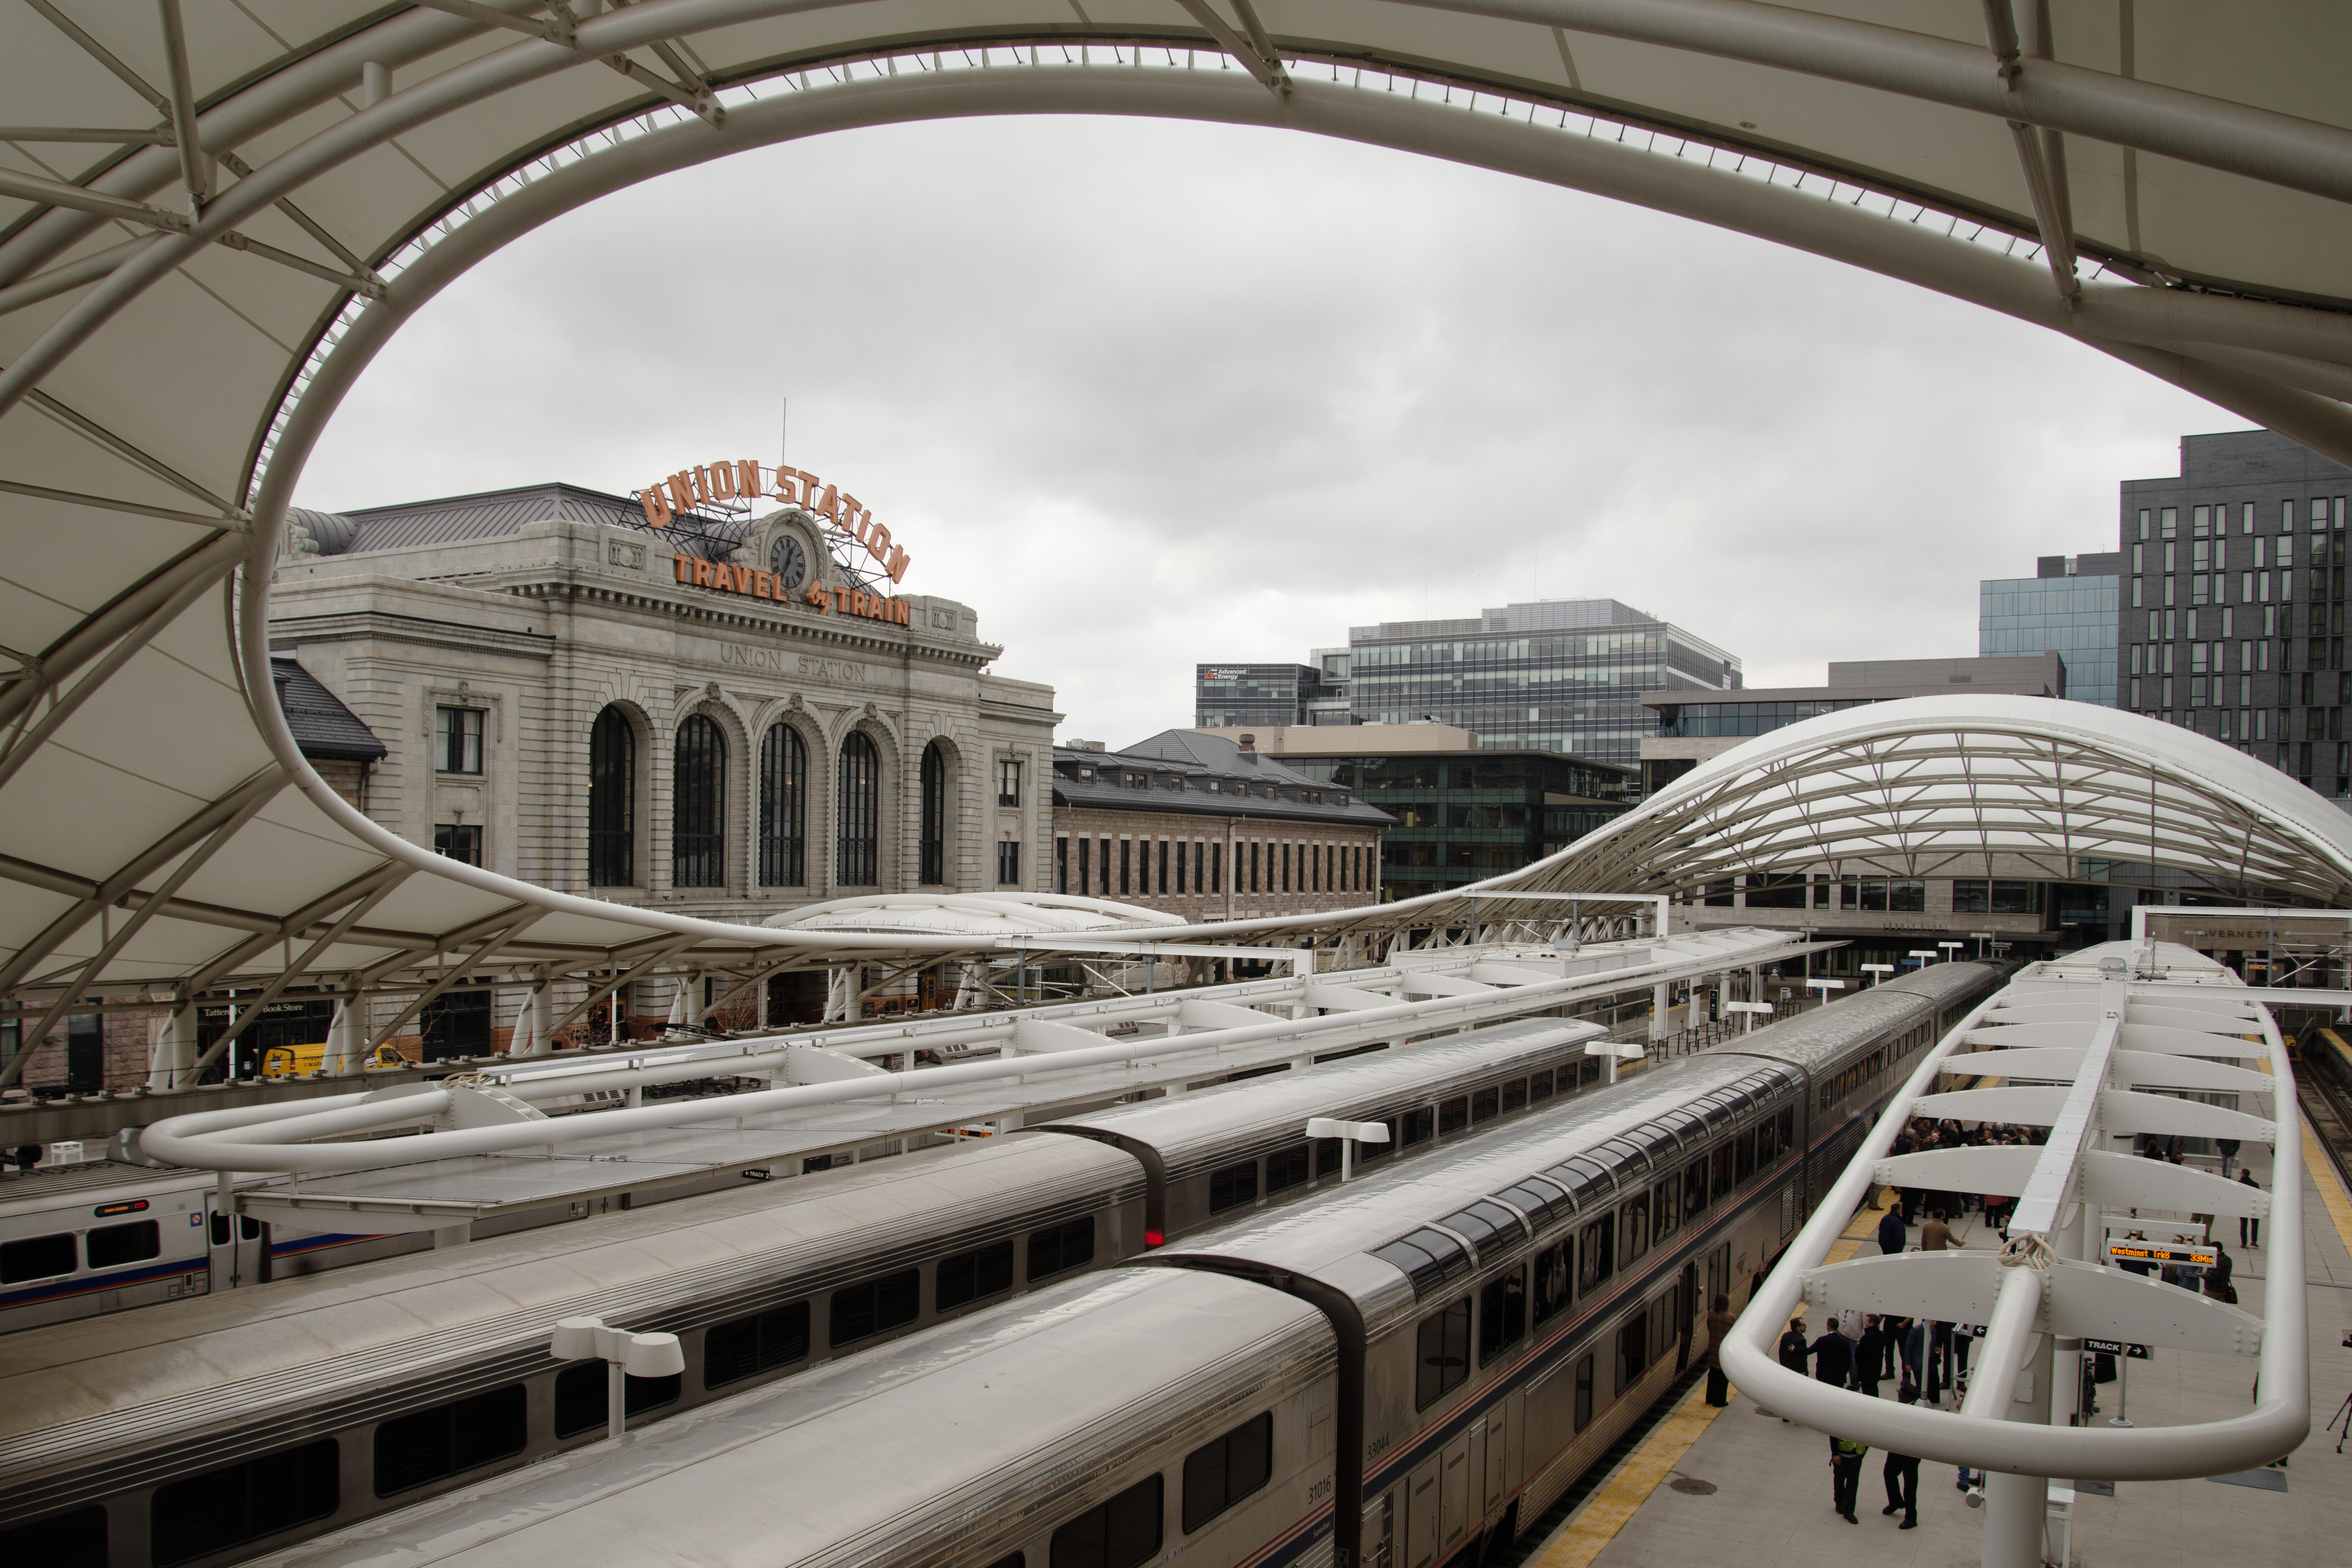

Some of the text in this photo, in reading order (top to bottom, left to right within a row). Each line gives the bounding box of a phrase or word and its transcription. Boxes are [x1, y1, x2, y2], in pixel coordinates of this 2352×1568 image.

[640, 460, 761, 529] UNION
[775, 465, 910, 584] STATION
[674, 553, 788, 601] TRAVEL
[806, 580, 833, 615] by
[834, 586, 909, 625] TRAIN
[721, 644, 866, 681] UNION STATION
[283, 1003, 304, 1011] Store
[2111, 1246, 2213, 1264] Westminst Trk8 33Min
[2088, 1341, 2132, 1354] TRACK 7
[1367, 1432, 1389, 1461] 33044
[1309, 1475, 1331, 1505] 31016
[1313, 1521, 1330, 1538] Superliner
